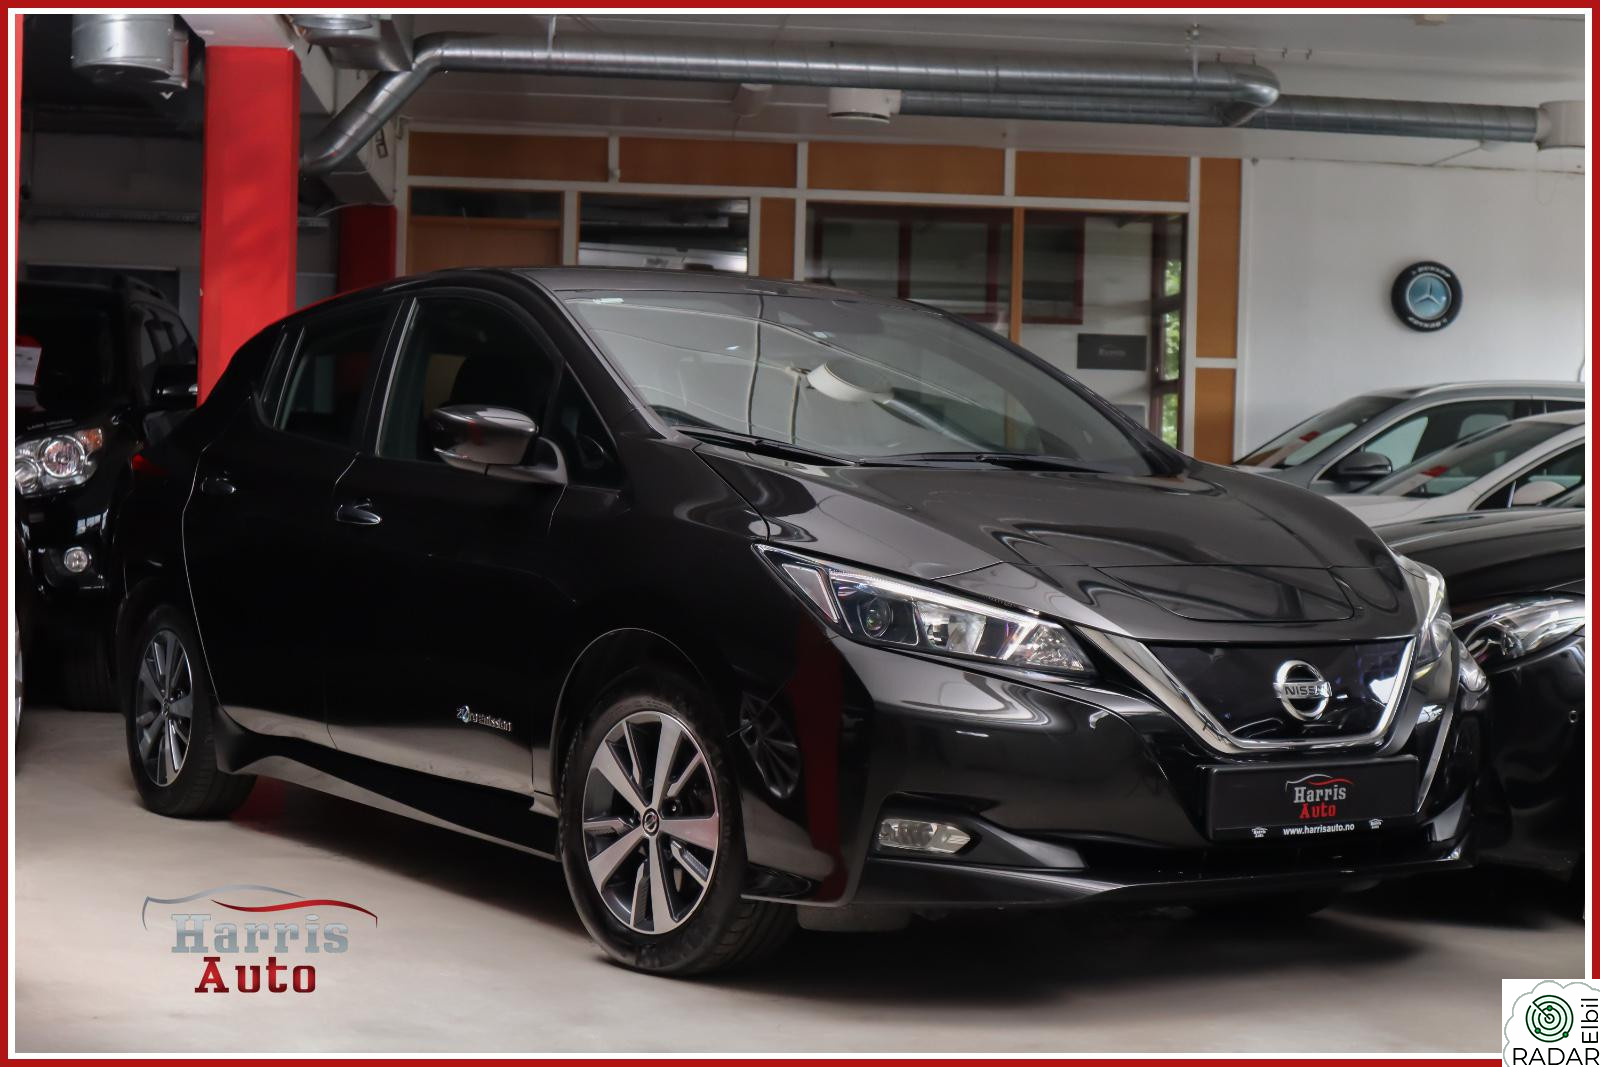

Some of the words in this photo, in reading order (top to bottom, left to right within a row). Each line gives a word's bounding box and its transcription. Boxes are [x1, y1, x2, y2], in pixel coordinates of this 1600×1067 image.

[1293, 785, 1347, 803] Harris
[1300, 802, 1337, 819] Auto
[1283, 823, 1355, 836] www.harrisauto.no
